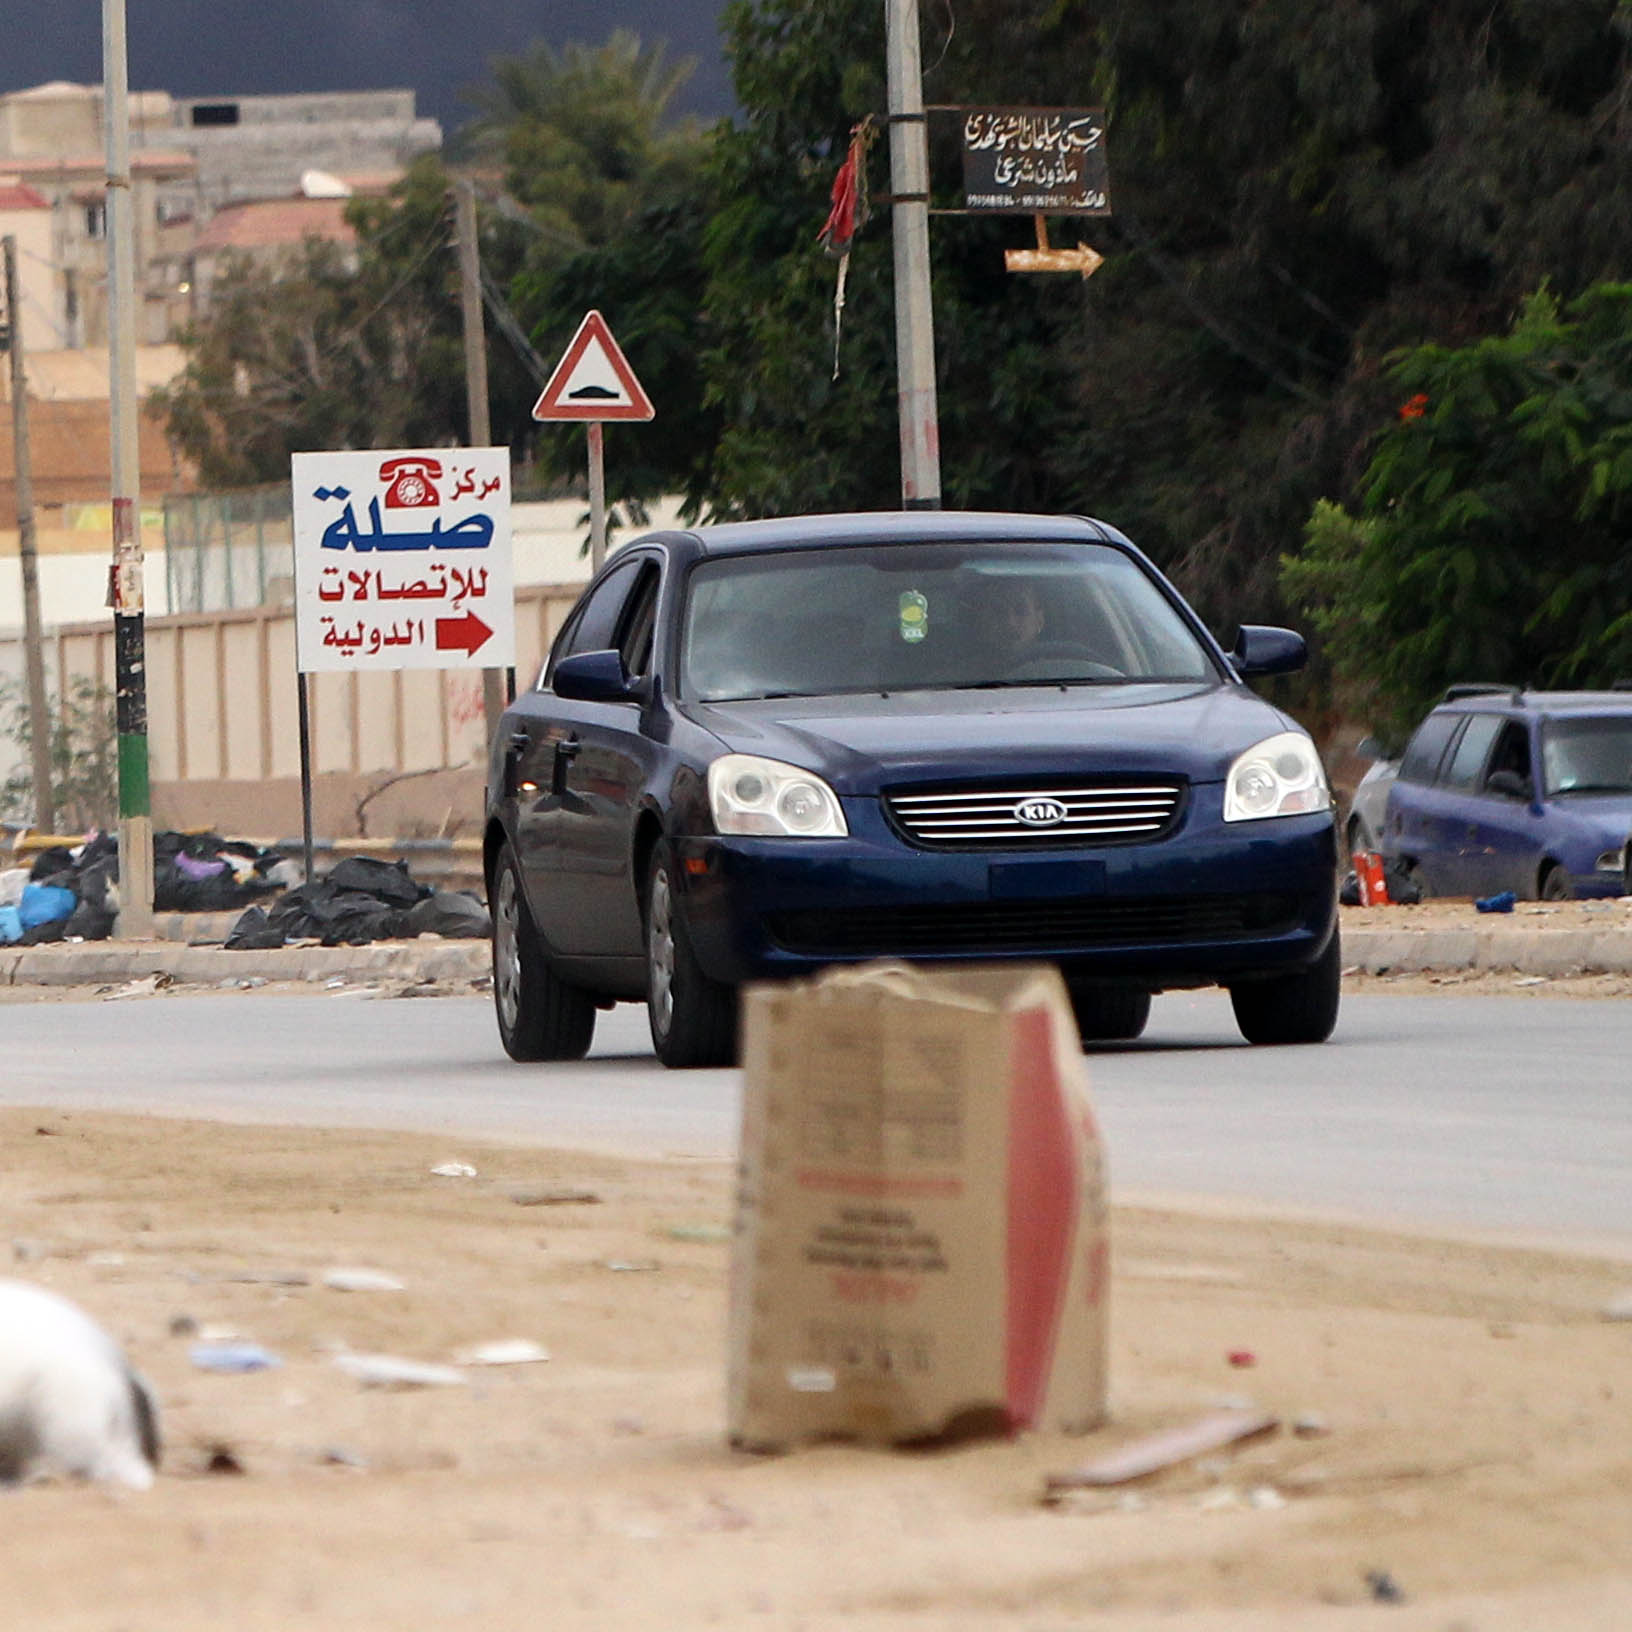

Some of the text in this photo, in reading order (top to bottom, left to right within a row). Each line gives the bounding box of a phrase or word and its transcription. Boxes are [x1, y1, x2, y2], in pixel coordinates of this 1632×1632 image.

[450, 466, 501, 501] مركز
[312, 485, 495, 552] صلة
[318, 564, 488, 610] للإتصالات
[320, 617, 425, 656] الدولية
[1024, 804, 1059, 820] KIA
